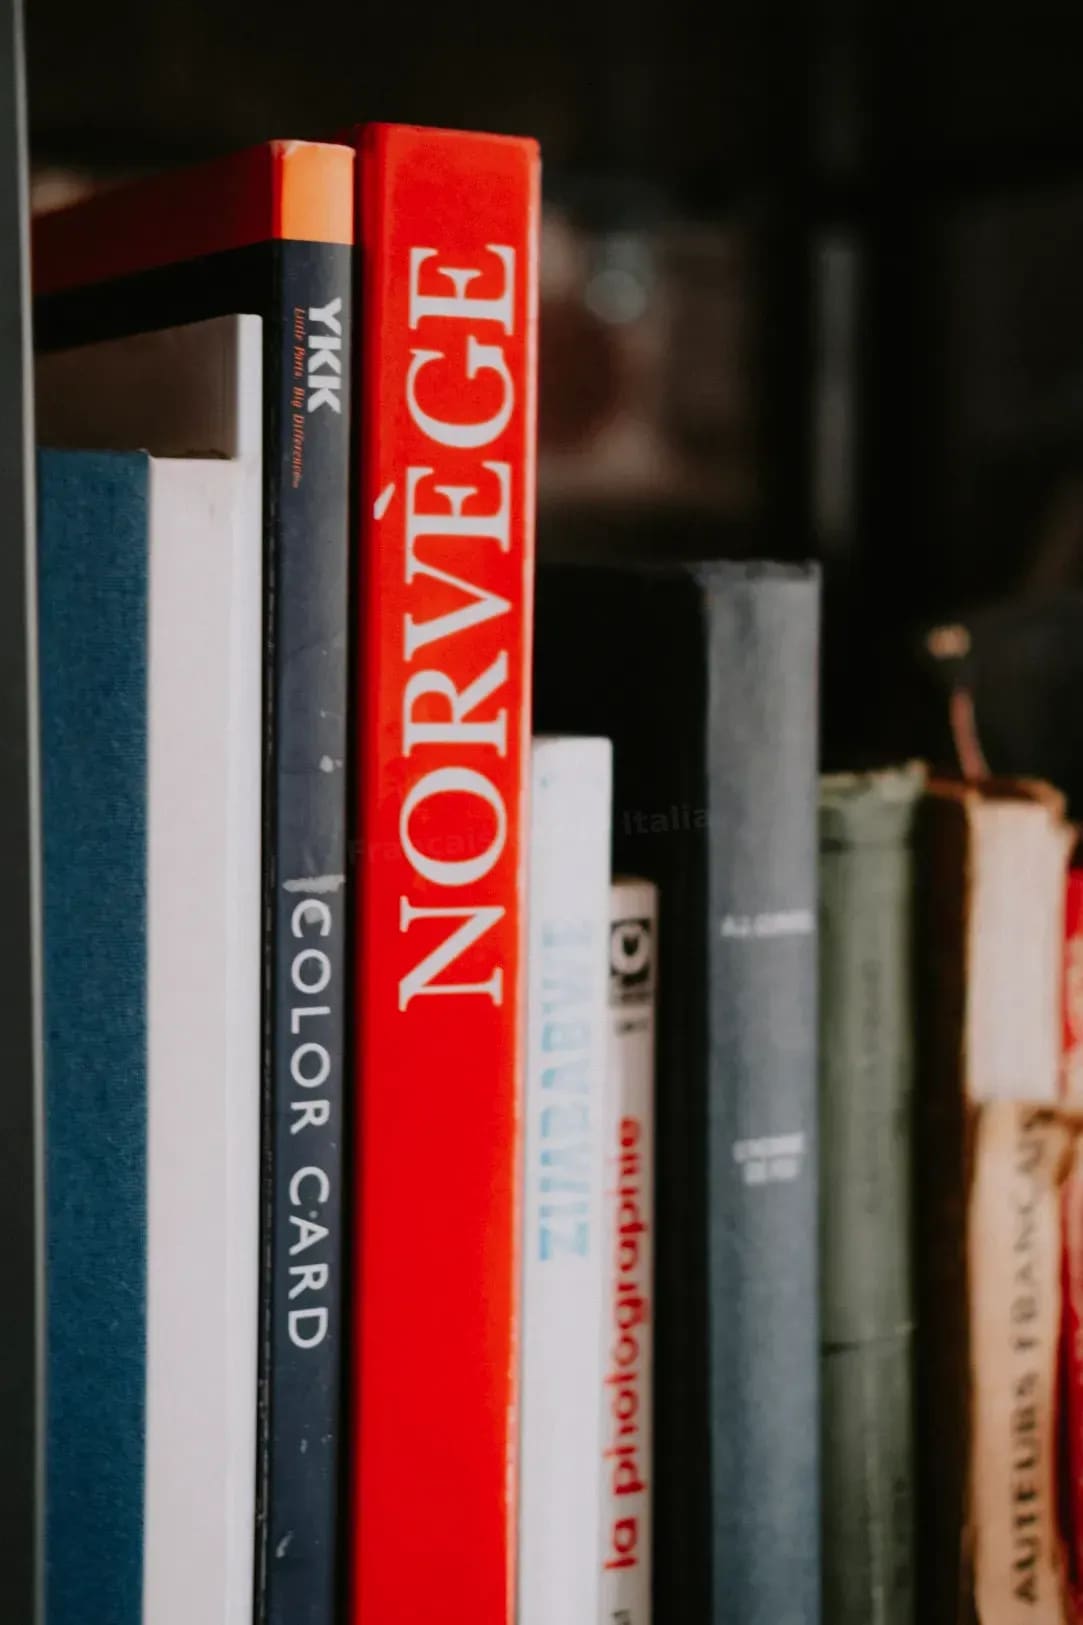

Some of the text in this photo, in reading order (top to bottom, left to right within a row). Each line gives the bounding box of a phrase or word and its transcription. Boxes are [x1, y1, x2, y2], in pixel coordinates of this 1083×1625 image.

[290, 387, 305, 408] Big
[307, 297, 343, 414] YKK
[374, 244, 515, 1011] NORVÈGE
[286, 898, 332, 1349] COLOR CARD
[603, 1115, 648, 1496] photographie
[603, 1517, 640, 1571] la
